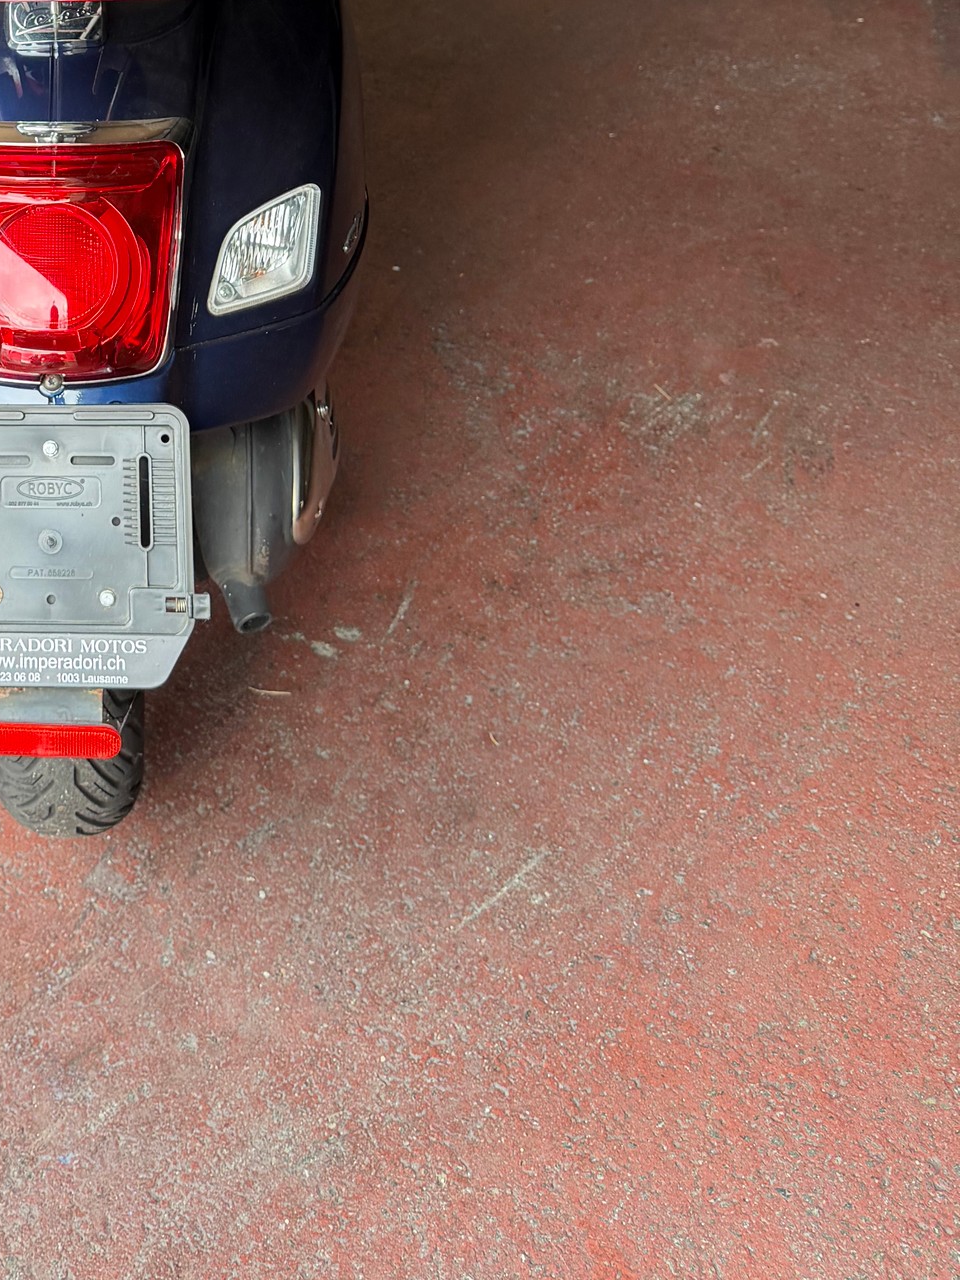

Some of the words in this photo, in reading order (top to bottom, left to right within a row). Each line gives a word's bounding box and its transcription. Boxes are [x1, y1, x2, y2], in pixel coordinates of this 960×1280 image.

[28, 482, 73, 495] ROBYC
[80, 638, 148, 654] MOTOS
[13, 671, 27, 683] 06
[27, 671, 41, 683] 08
[56, 672, 80, 684] 1003
[81, 673, 129, 685] Lausanne
